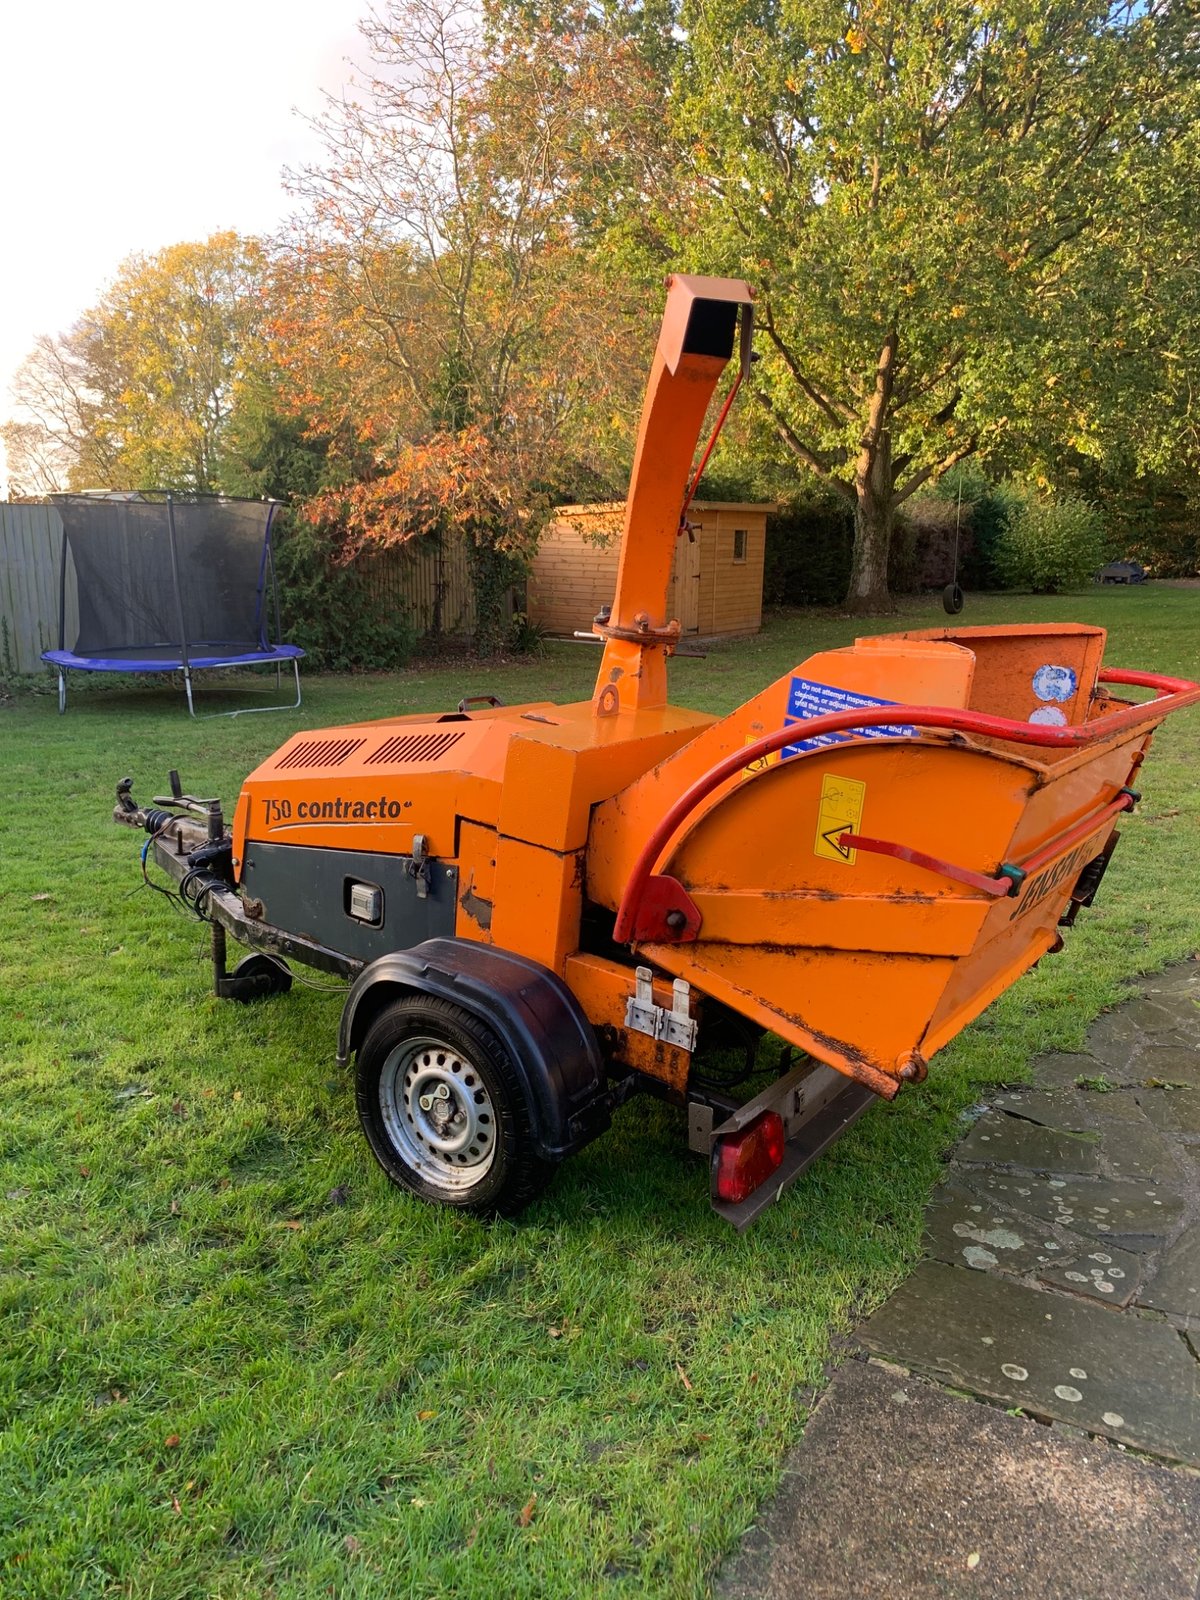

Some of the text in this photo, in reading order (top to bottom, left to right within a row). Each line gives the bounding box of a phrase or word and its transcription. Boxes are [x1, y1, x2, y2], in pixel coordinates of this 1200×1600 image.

[801, 682, 810, 691] Do
[811, 685, 821, 693] not
[822, 688, 846, 700] attempt
[794, 700, 808, 708] until
[808, 703, 818, 711] the
[802, 710, 812, 718] the
[888, 724, 902, 734] and
[903, 729, 912, 737] all
[262, 797, 413, 825] 750 contracto
